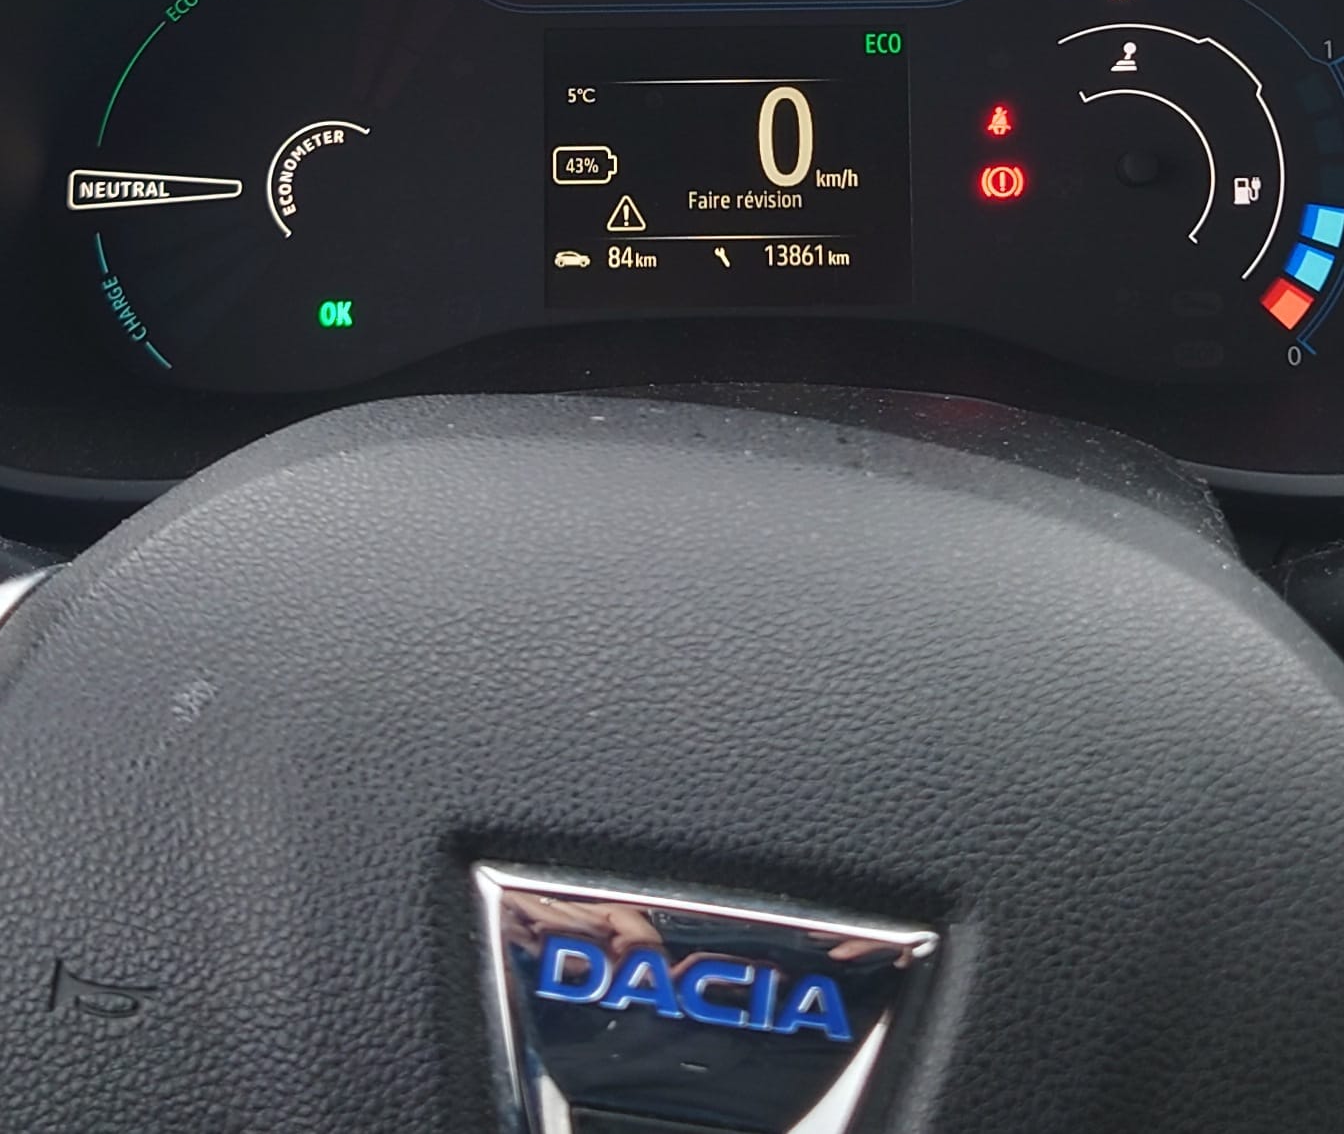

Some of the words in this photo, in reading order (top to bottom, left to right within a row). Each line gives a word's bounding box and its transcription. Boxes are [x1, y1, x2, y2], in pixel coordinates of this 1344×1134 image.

[864, 33, 902, 54] ECO
[567, 87, 597, 104] 5°C
[757, 86, 814, 187] 0
[815, 169, 859, 190] km/h
[277, 129, 345, 217] ECONOMETER
[565, 157, 599, 174] 43%
[79, 180, 170, 199] NEUTRAL
[688, 191, 731, 210] Faire
[736, 190, 803, 209] révision
[101, 275, 148, 341] CHARGE
[319, 301, 353, 327] OK
[535, 933, 854, 1042] DACIA
